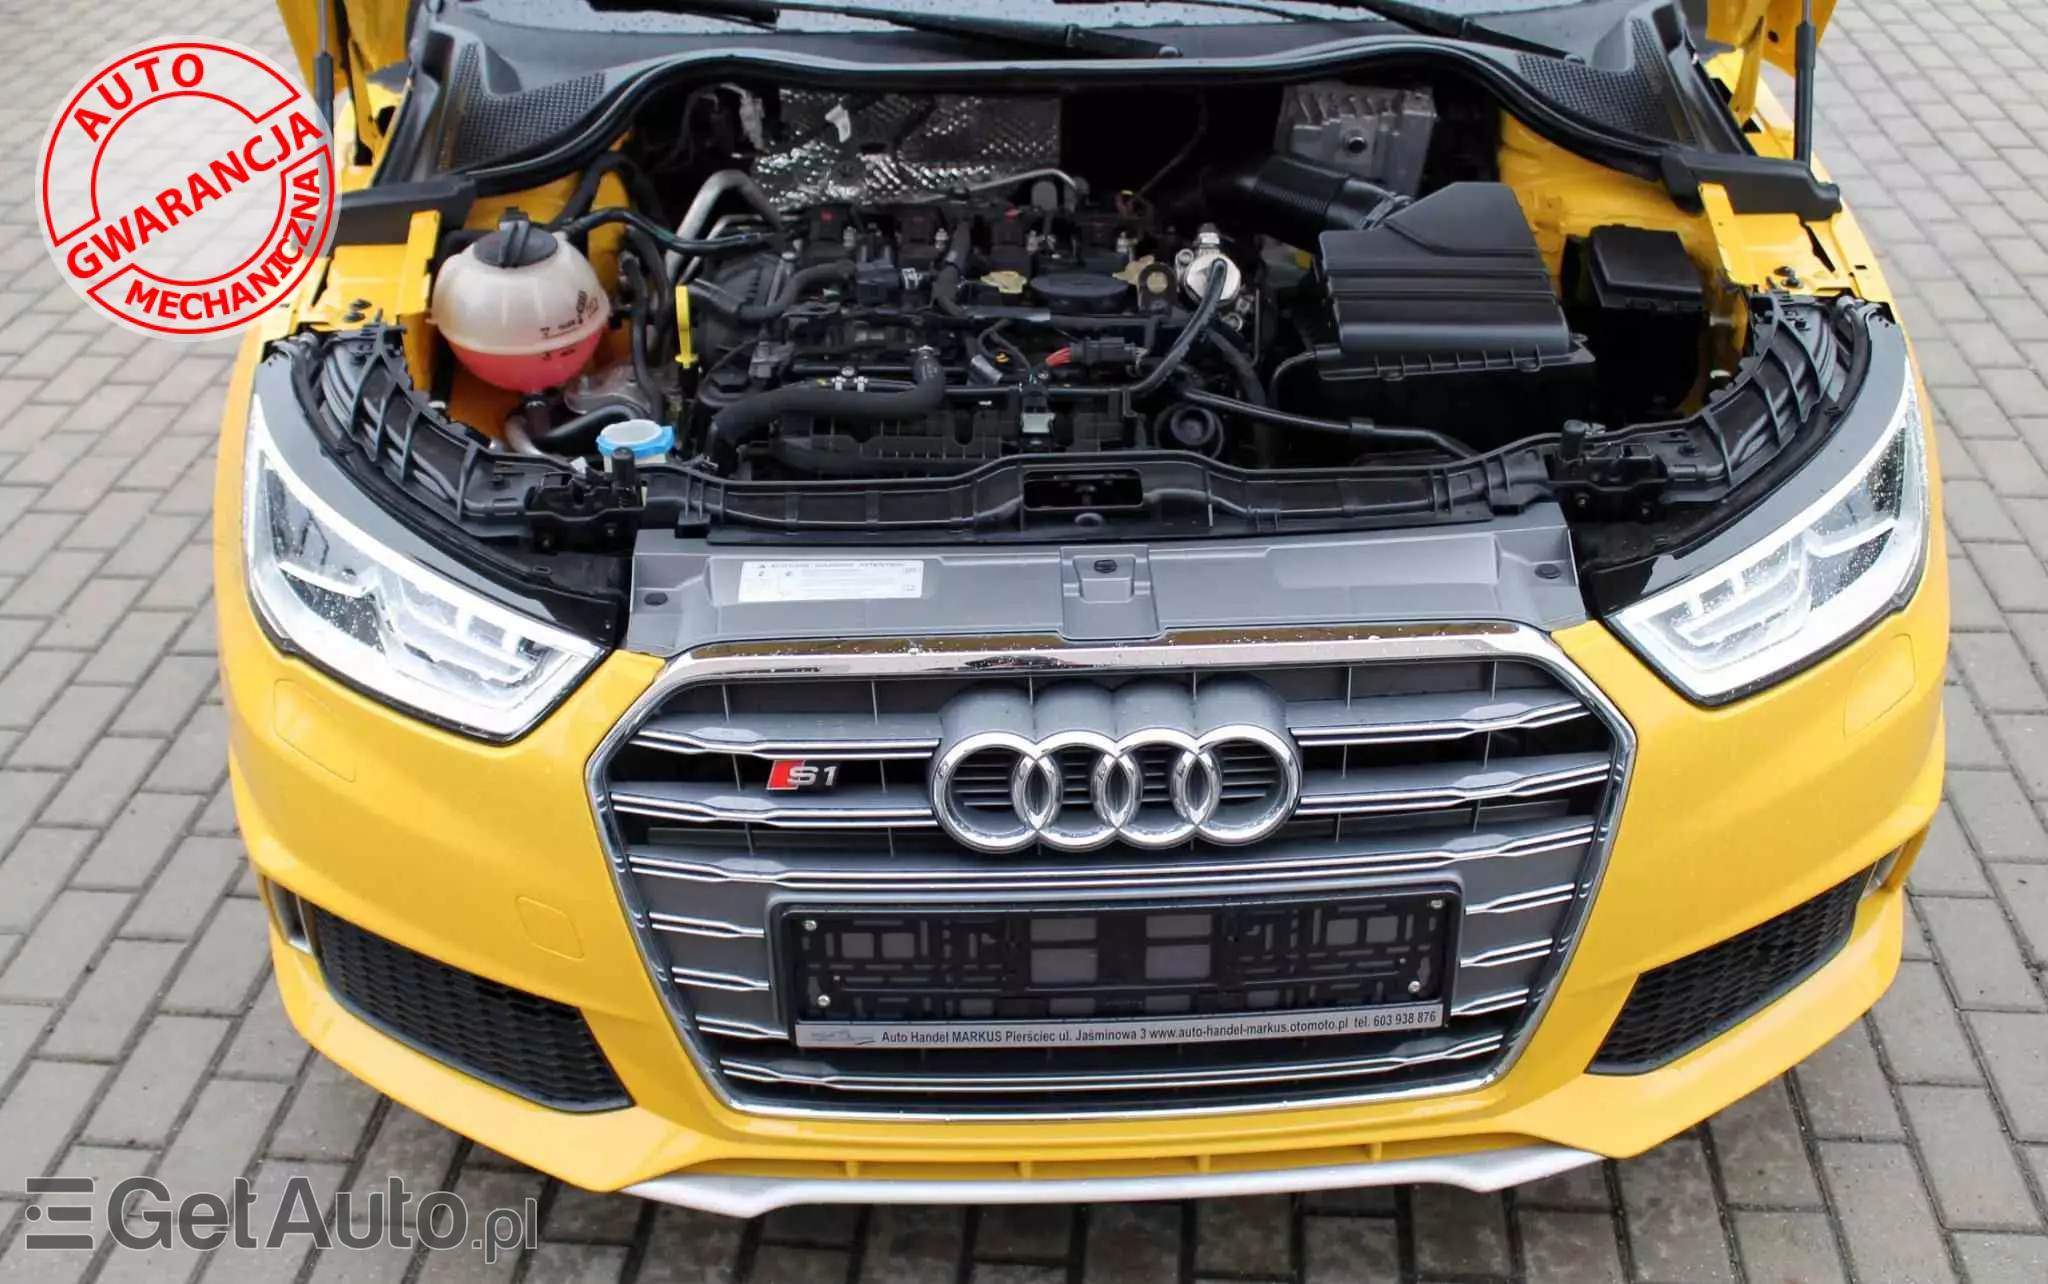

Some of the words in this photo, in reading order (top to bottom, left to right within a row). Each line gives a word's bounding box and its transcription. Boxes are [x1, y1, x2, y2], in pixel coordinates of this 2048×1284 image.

[787, 765, 838, 787] S1
[881, 1031, 908, 1043] Auto
[910, 1031, 949, 1044] Handel
[952, 1030, 1002, 1043] MARKUS
[1058, 1030, 1073, 1042] ul.
[1139, 1027, 1147, 1040] 3
[1149, 1016, 1349, 1039] www.auto-handel-markus.otomoto.pl
[1353, 1016, 1370, 1029] tel.
[1373, 1014, 1394, 1027] 603
[1395, 1012, 1415, 1025] 938
[1416, 1010, 1438, 1024] 876
